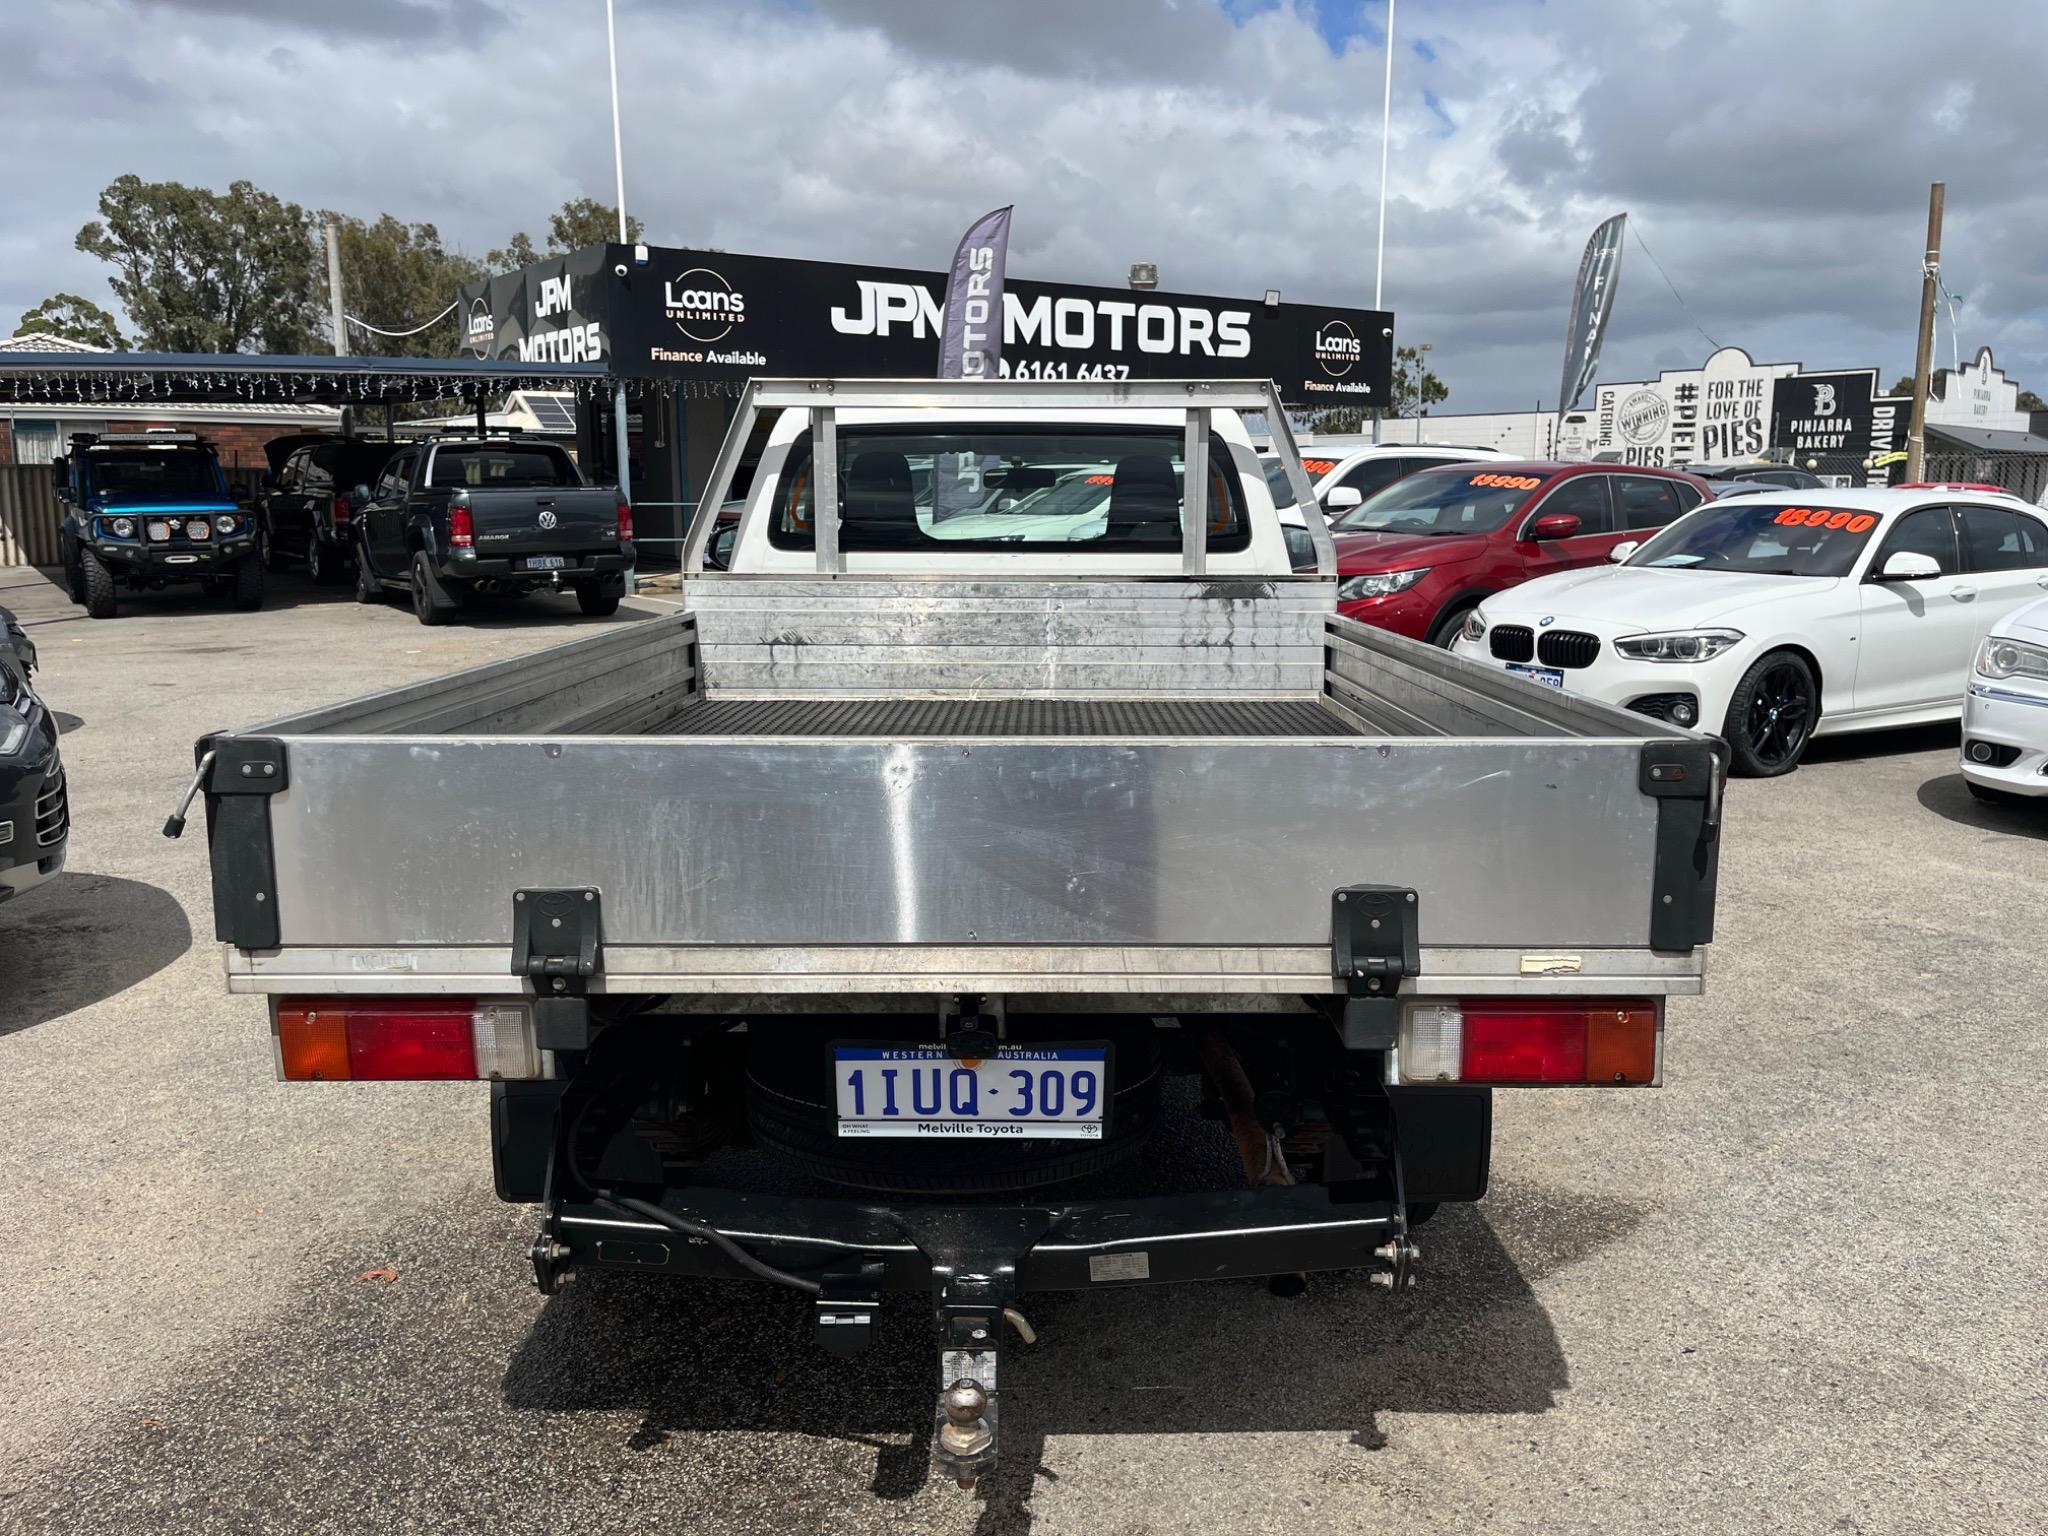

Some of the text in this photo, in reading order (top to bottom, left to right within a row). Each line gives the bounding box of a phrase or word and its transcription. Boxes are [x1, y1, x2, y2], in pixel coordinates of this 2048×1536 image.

[535, 273, 572, 318] JPM
[664, 281, 744, 312] Loans
[468, 313, 494, 335] Loans
[665, 309, 745, 323] UNLIMITED
[961, 247, 993, 380] OTORS
[1002, 292, 1251, 358] MOTORS
[518, 322, 602, 363] MOTORS
[1315, 330, 1360, 353] Loans
[650, 347, 767, 365] Finance Available
[1315, 352, 1360, 361] UNLIMITED
[1304, 380, 1371, 393] Finance Available
[1707, 378, 1764, 399] FOR THE
[1599, 391, 1615, 447] CATERING
[1621, 403, 1666, 431] WINNING
[1706, 400, 1762, 420] LOVE OF
[1790, 418, 1852, 434] PINJARRA
[1703, 418, 1763, 461] PIES
[1796, 434, 1845, 449] BAKERY
[1626, 447, 1665, 468] PIES
[882, 1051, 1059, 1060] WESTERN AUSTRALIA
[918, 1124, 1024, 1136] Melville Toyota
